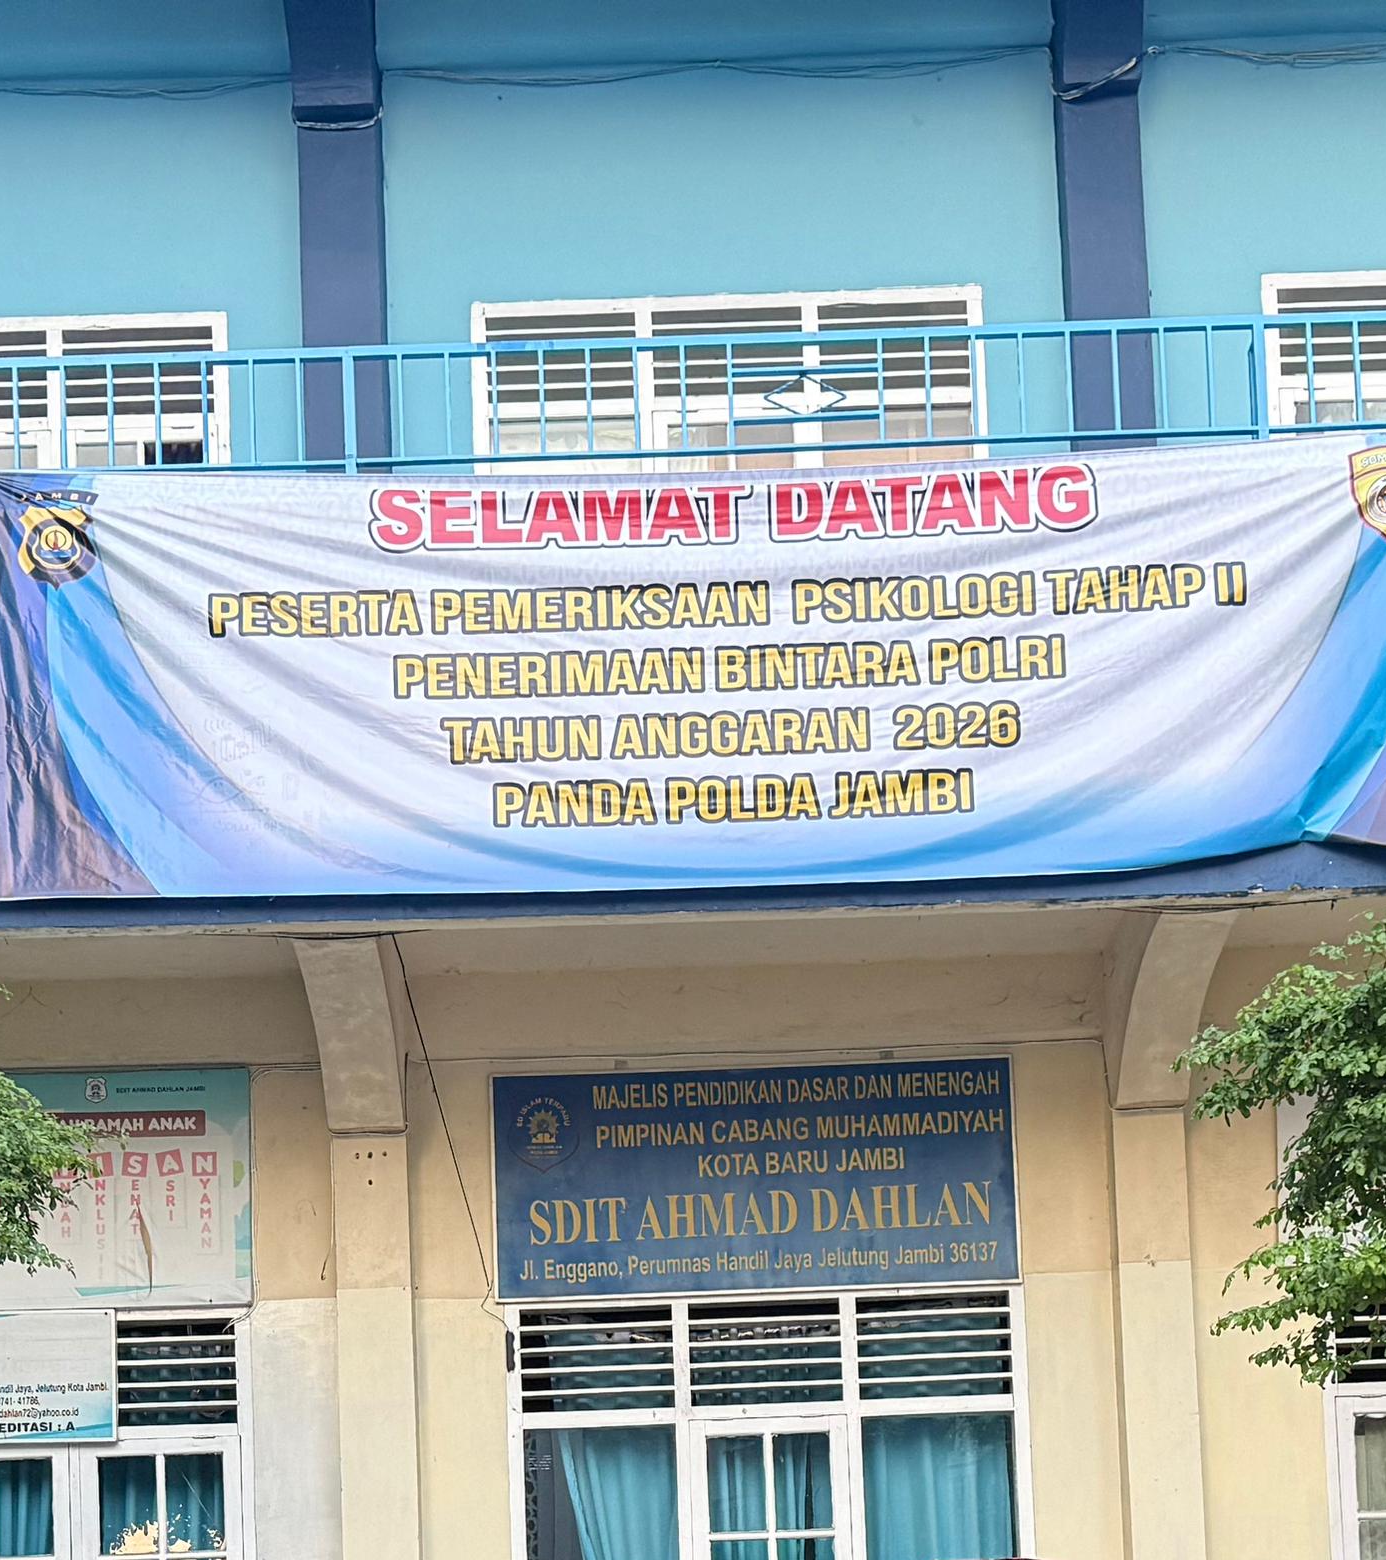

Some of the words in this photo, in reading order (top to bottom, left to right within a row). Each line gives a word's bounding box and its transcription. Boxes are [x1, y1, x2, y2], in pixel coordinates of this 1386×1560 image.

[372, 484, 751, 551] SELAMAT
[769, 463, 1097, 543] DATANG
[209, 590, 420, 637] PESERTA
[431, 581, 769, 635] PEMERIKSAAN
[790, 571, 1036, 623] PSIKOLOGI
[1045, 563, 1205, 614] TAHAP
[1214, 561, 1247, 605] II
[393, 647, 705, 698] PENERIMAAN
[715, 641, 919, 692] BINTARA
[929, 634, 1066, 684] POLRI
[441, 715, 601, 764] TAHUN
[610, 706, 870, 761] ANGGARAN
[892, 699, 1022, 750] 2026
[493, 778, 657, 827] PANDA
[665, 772, 823, 823] POLDA
[829, 767, 974, 819] JAMBI
[592, 1084, 668, 1109] MAJELIS
[673, 1078, 782, 1106] PENDIDIKAN
[786, 1076, 849, 1102] DASAR
[853, 1074, 891, 1099] DAN
[896, 1071, 1000, 1097] MENENGAH
[148, 1116, 196, 1131] ANAK
[597, 1120, 705, 1148] PIMPINAN
[712, 1115, 809, 1144] CABANG
[816, 1109, 1004, 1139] MUHAMMADIYAH
[698, 1152, 760, 1177] KOTA
[765, 1150, 828, 1175] BARU
[835, 1147, 905, 1172] JAMBI
[529, 1196, 626, 1245] SDIT
[635, 1190, 797, 1241] AHMAD
[811, 1181, 991, 1233] DAHLAN
[520, 1261, 539, 1281] Jl.
[545, 1259, 623, 1284] Enggano,
[628, 1255, 710, 1276] Perumnas
[717, 1252, 768, 1272] Handil
[774, 1250, 812, 1272] Jaya
[818, 1246, 888, 1271] Jelutung
[895, 1244, 944, 1266] Jambi
[949, 1241, 997, 1263] 36137
[36, 1383, 66, 1394] Jelutung
[68, 1383, 84, 1392] Kota
[65, 1421, 75, 1432] A
